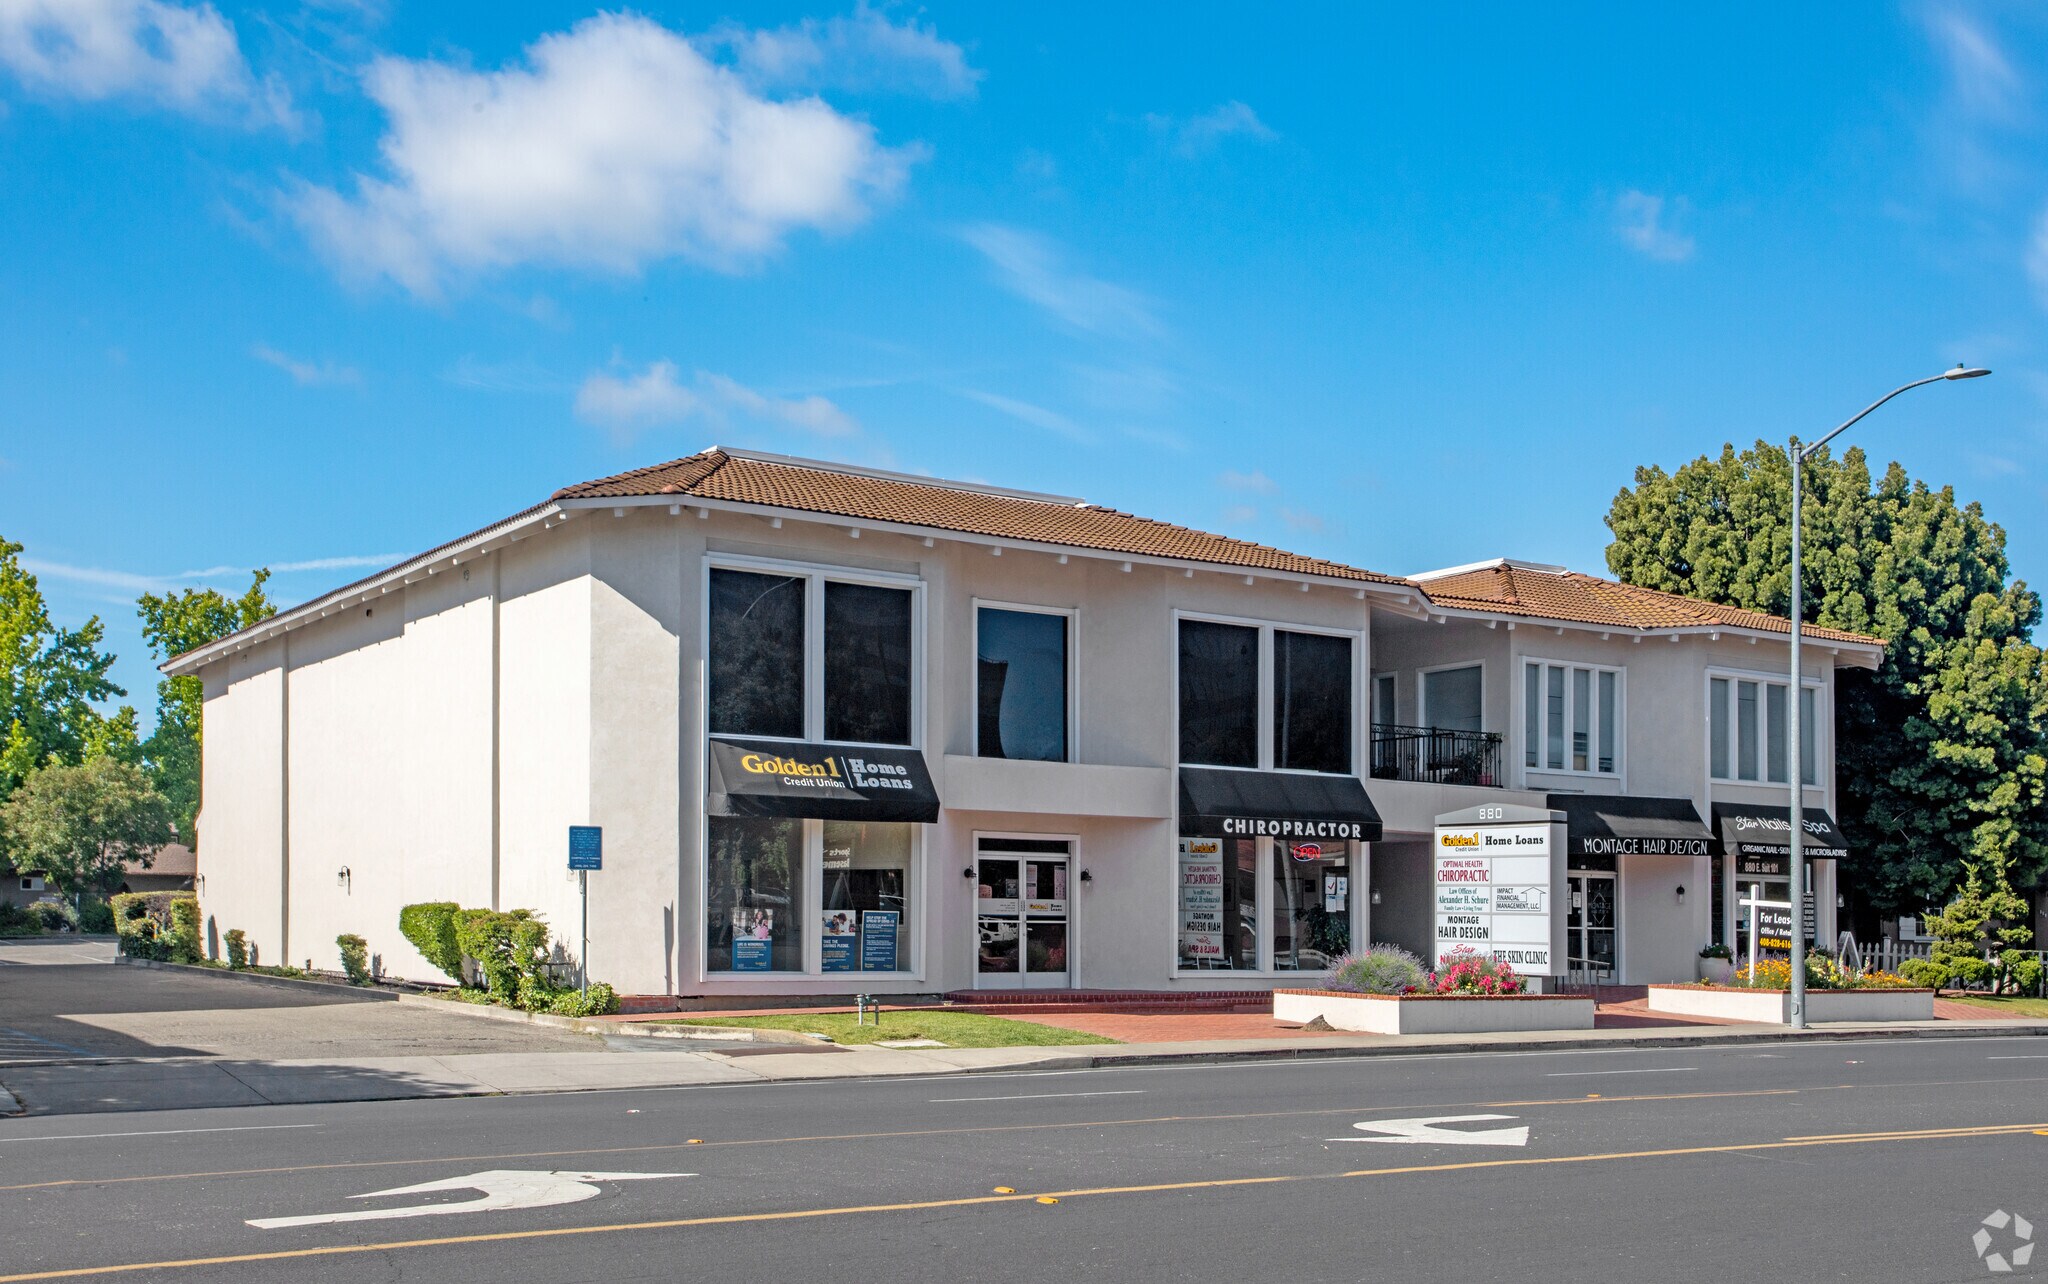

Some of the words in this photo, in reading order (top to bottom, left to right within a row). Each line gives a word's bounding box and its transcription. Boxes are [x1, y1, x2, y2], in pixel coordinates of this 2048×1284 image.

[741, 754, 842, 778] Golden1
[849, 758, 908, 776] Home
[784, 776, 815, 787] Credit
[816, 778, 846, 788] Union
[853, 773, 913, 790] Loans
[1480, 808, 1502, 820] 880
[1223, 818, 1361, 838] CHIROPRACTOR
[1736, 816, 1758, 830] Star
[1757, 816, 1792, 830] Nails
[1802, 820, 1831, 834] Spa
[1485, 836, 1512, 846] Home
[1516, 835, 1544, 844] Loans
[1584, 838, 1638, 854] MONTAGE
[1642, 839, 1666, 854] HAIR
[1670, 840, 1708, 854] DESIGN
[1293, 846, 1320, 858] OPEN
[1742, 844, 1766, 853] ORGANIC
[1810, 848, 1847, 856] MICROBLADING
[1438, 870, 1489, 882] CHIROPRACTIC
[1438, 896, 1463, 904] Alexander
[1448, 916, 1479, 924] MONTAGE
[1760, 912, 1772, 923] For
[1774, 913, 1792, 924] Leas
[1438, 926, 1457, 938] HAIR
[1460, 926, 1488, 939] DESIGN
[1761, 927, 1774, 935] Office
[1774, 928, 1779, 936] /
[1452, 944, 1475, 954] Star
[1760, 938, 1792, 949] 408-828-616
[1508, 950, 1523, 964] SKIN
[1525, 951, 1547, 964] CLINIC
